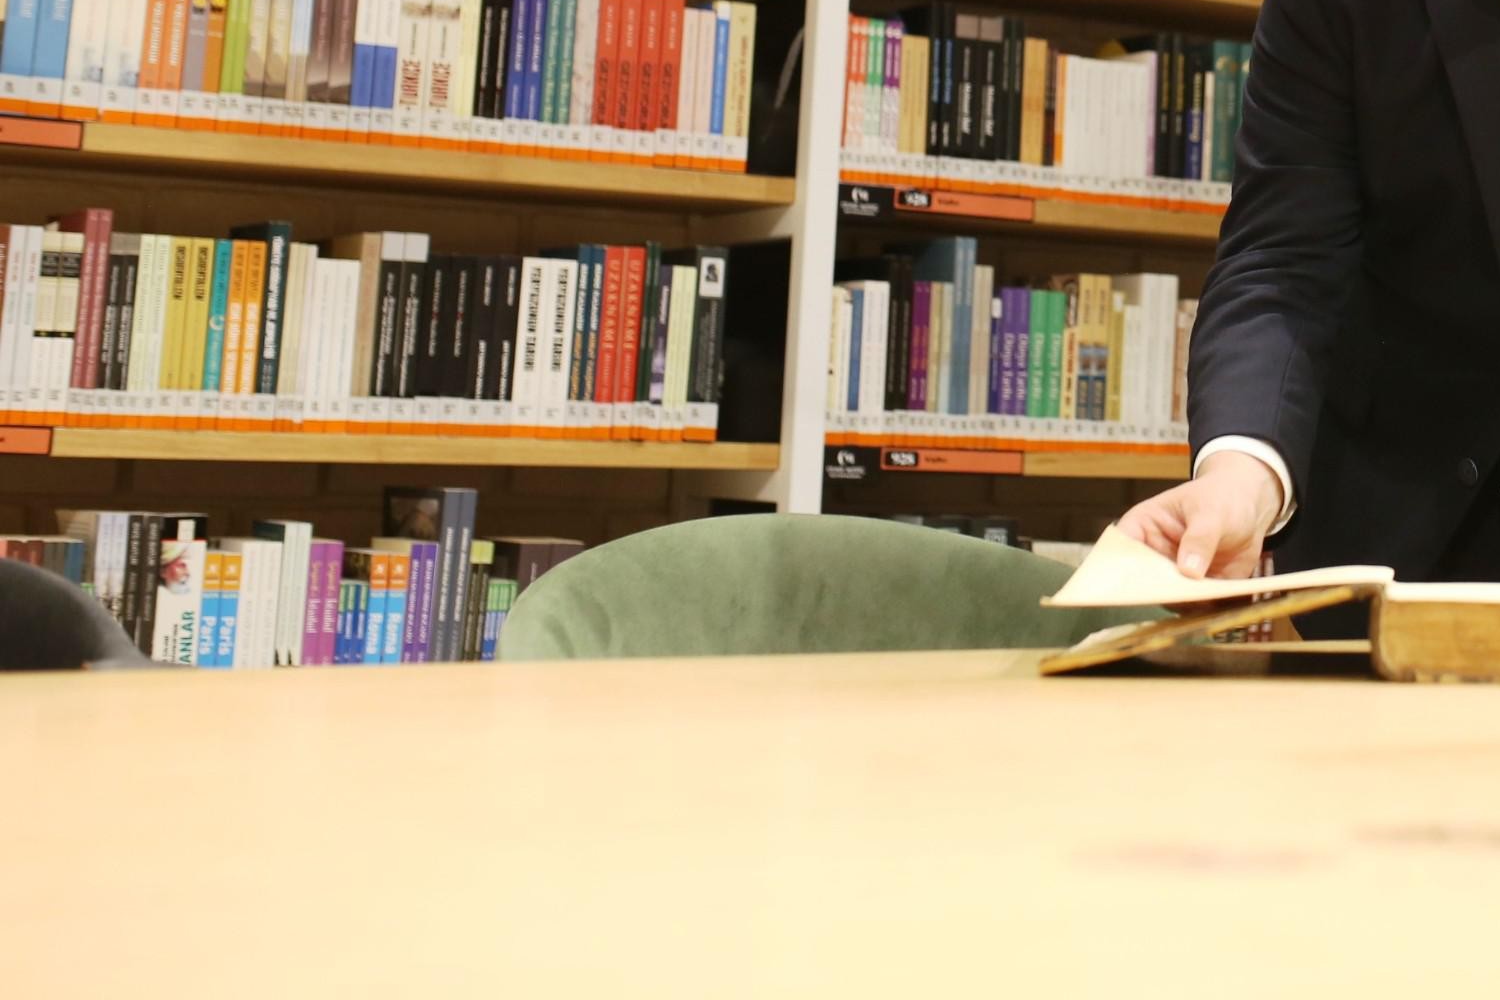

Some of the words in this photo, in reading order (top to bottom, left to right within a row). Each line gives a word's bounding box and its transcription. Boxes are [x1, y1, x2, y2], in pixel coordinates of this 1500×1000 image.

[179, 612, 194, 664] ANLAR
[201, 615, 217, 656] Paris
[219, 615, 235, 656] Paris
[366, 612, 382, 654] Roma
[385, 612, 402, 654] Roma
